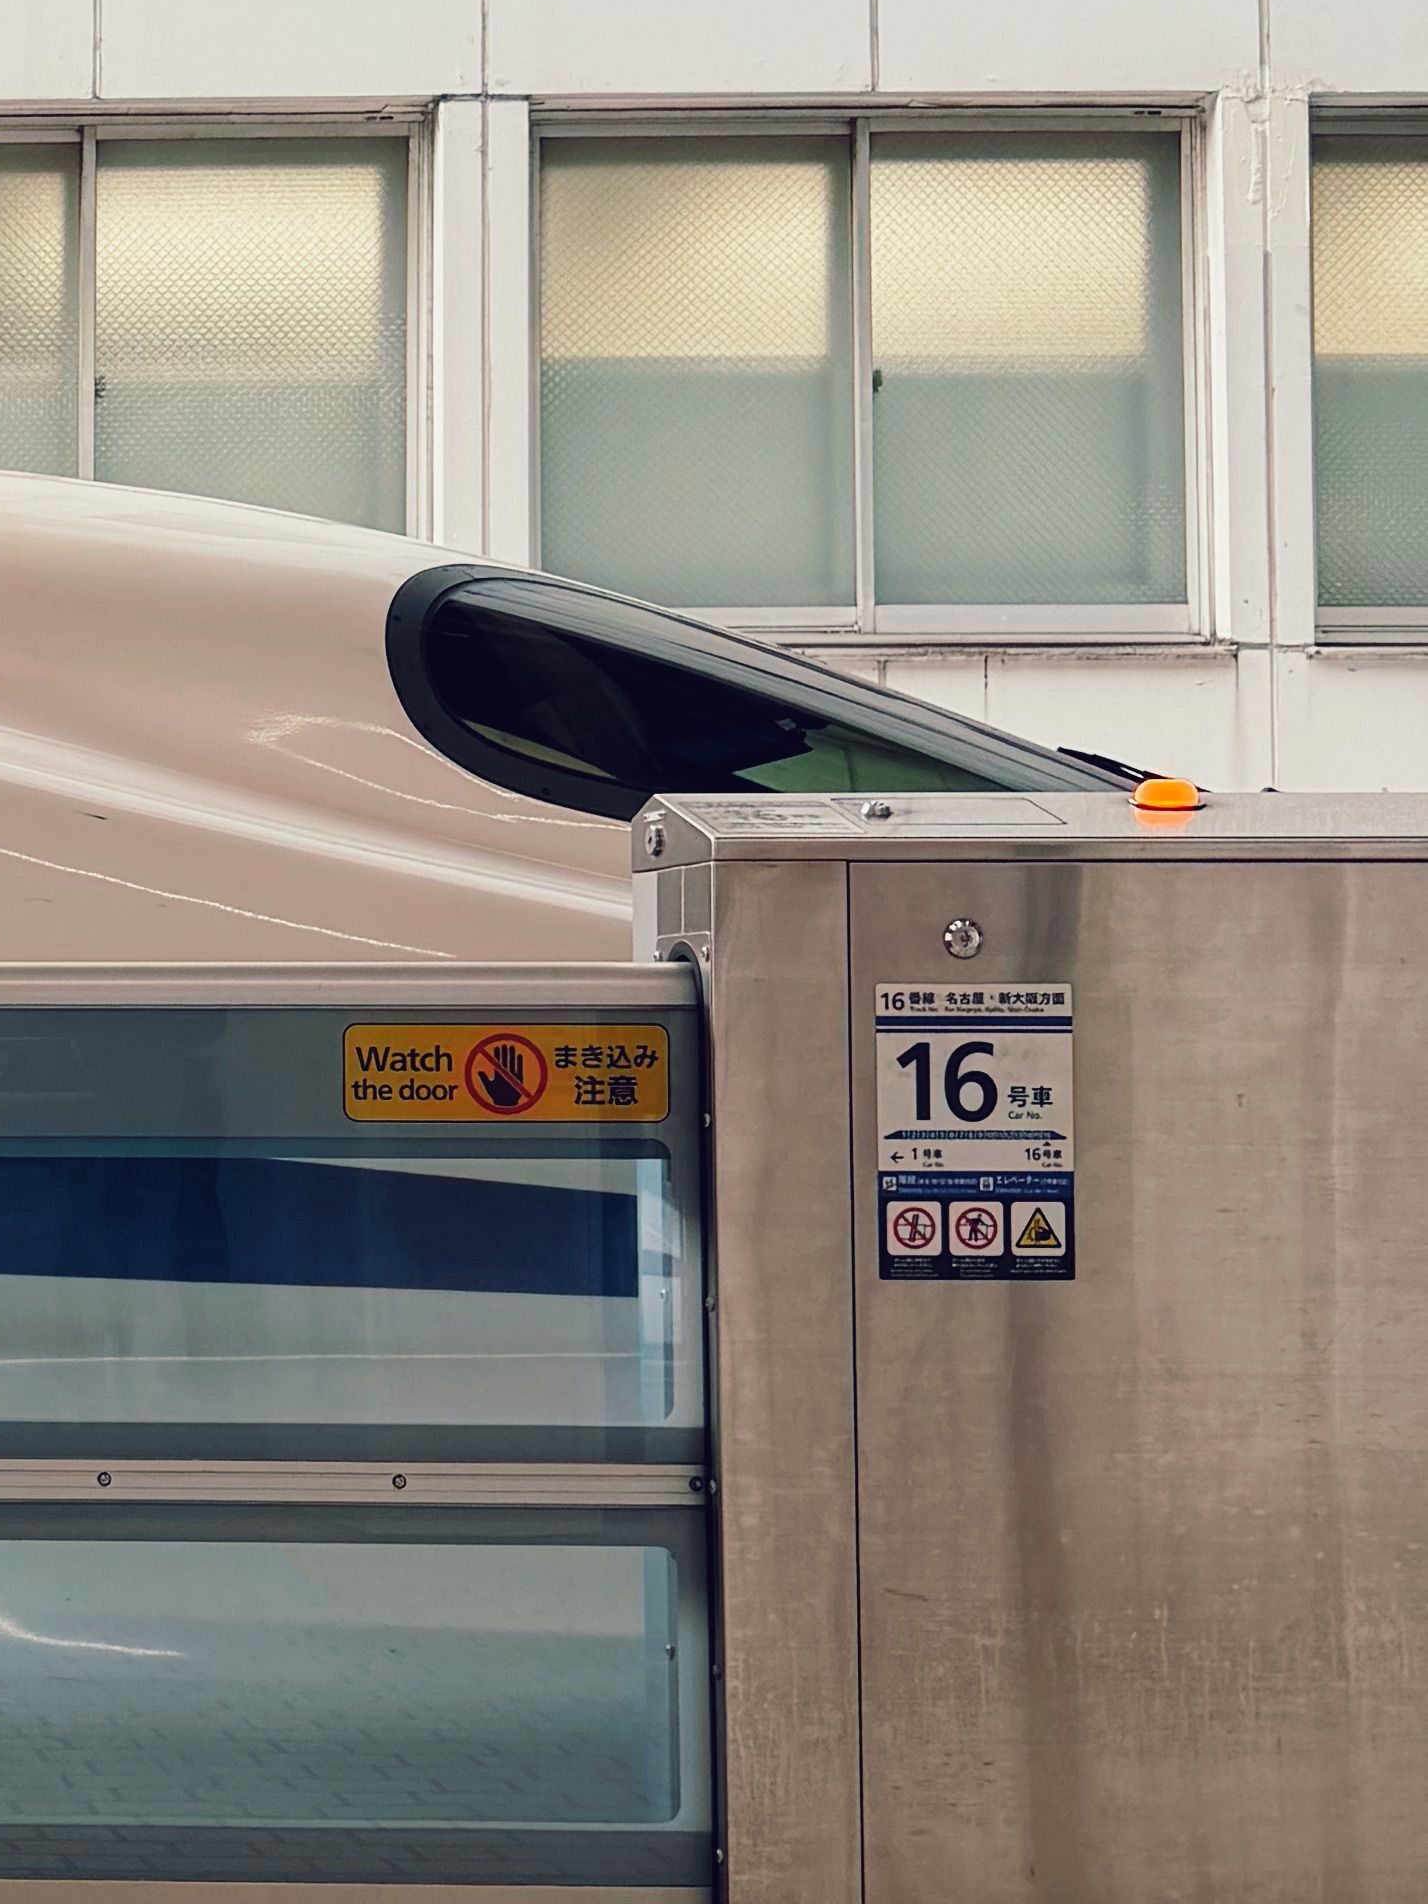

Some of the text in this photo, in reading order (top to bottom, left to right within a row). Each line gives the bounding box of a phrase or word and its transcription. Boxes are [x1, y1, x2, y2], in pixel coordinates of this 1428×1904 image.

[355, 1044, 453, 1072] Watch
[554, 1043, 659, 1070] まき込み
[352, 1077, 459, 1102] the door
[574, 1075, 639, 1106] 注意
[1007, 1110, 1043, 1120] Car No.
